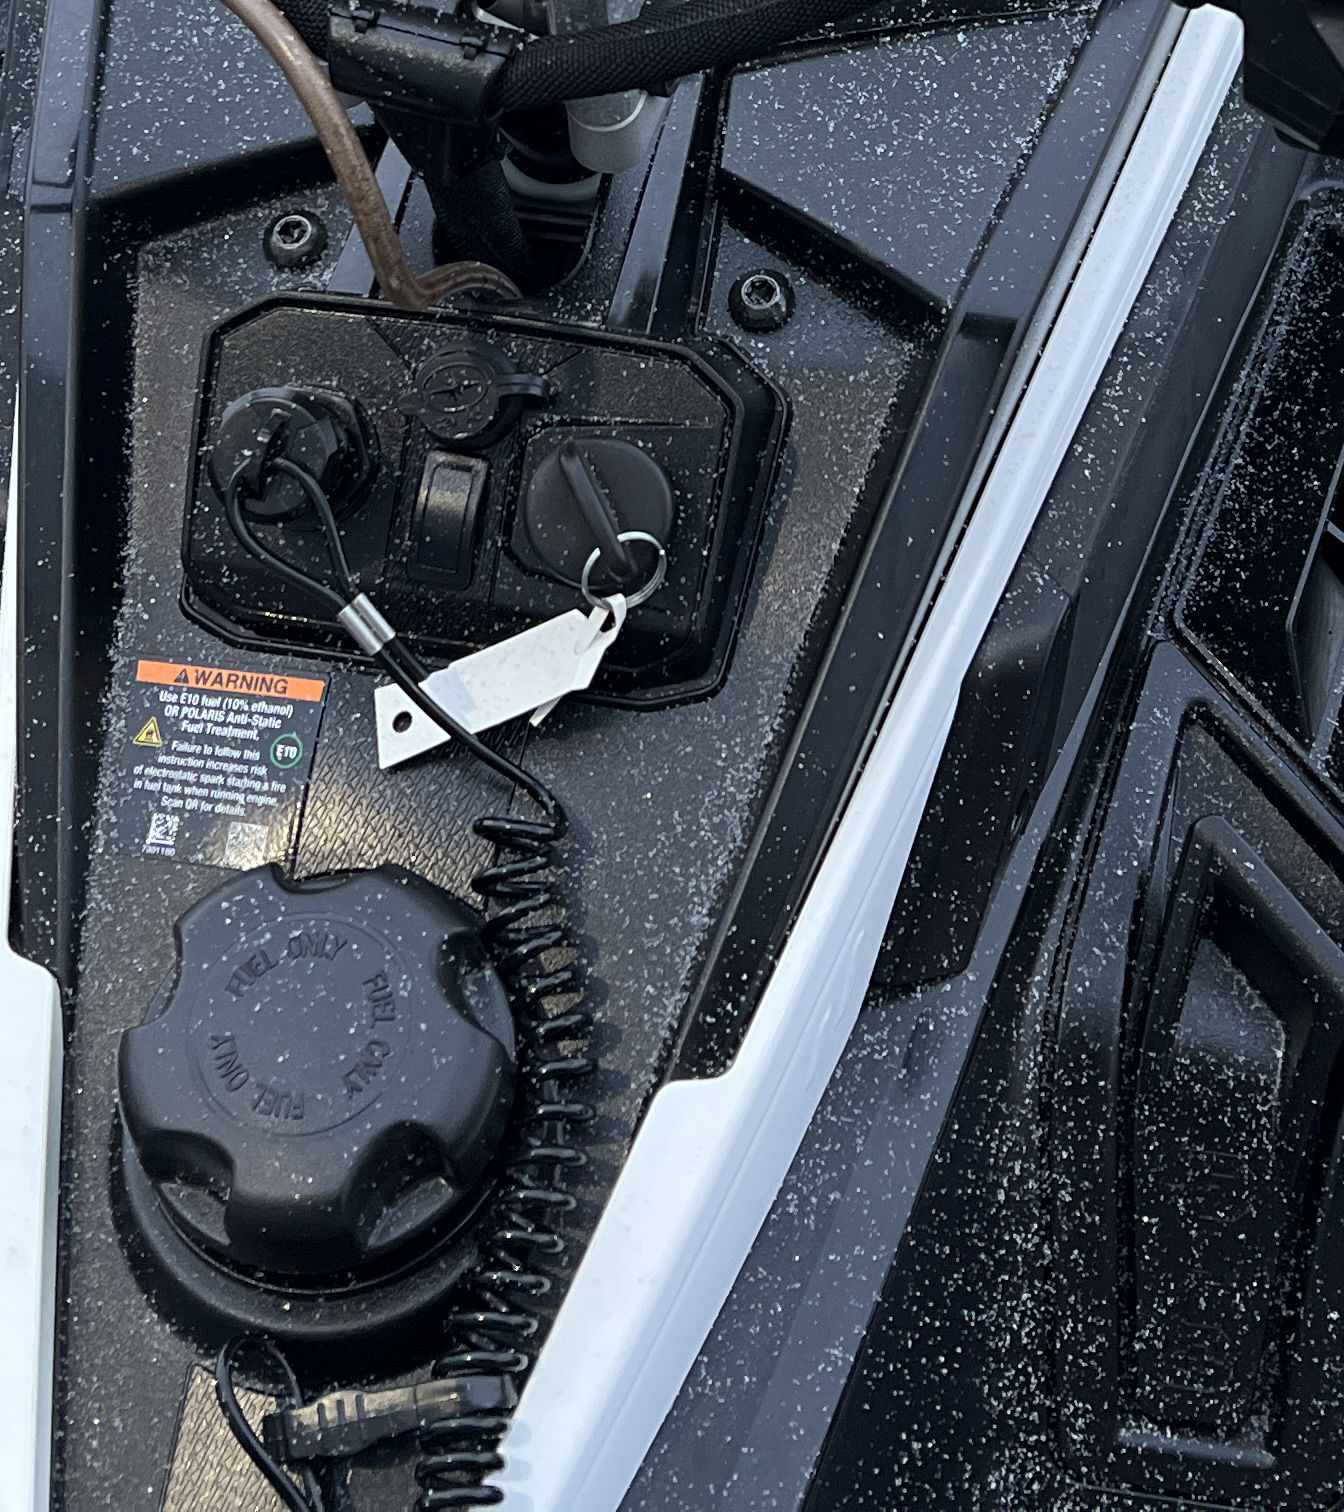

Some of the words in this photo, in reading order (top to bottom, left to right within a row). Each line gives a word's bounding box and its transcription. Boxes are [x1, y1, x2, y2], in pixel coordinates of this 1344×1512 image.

[195, 669, 288, 695] WARNING
[159, 690, 178, 703] Use
[180, 692, 200, 705] E10
[201, 694, 221, 707] fuel
[222, 697, 249, 711] (10%
[250, 701, 293, 718] ethanol)
[164, 704, 179, 716] OR
[180, 706, 225, 722] POLARIS
[226, 712, 282, 729] Anti-Static
[180, 720, 203, 733] Fuel
[171, 740, 202, 754] Failure
[203, 744, 213, 755] to
[214, 745, 241, 759] follow
[243, 749, 260, 761] this
[276, 744, 298, 759] E10
[157, 753, 204, 768] instruction
[205, 758, 248, 774] increases
[250, 765, 268, 777] risk
[133, 764, 144, 775] of
[144, 766, 198, 782] electrostatic
[199, 774, 225, 786] spark
[226, 776, 261, 792] starting
[270, 780, 286, 793] fire
[133, 778, 143, 789] in
[144, 779, 162, 791] fuel
[162, 782, 182, 793] tank
[184, 785, 209, 797] when
[210, 788, 245, 804] running
[160, 795, 183, 808] Scan
[185, 798, 199, 810] QR
[200, 800, 212, 812] for
[223, 949, 280, 999] FUEL
[285, 931, 348, 962] ONLY
[361, 969, 396, 1029] FUEL
[208, 1031, 250, 1092] ONLY
[252, 1082, 305, 1120] FUEL
